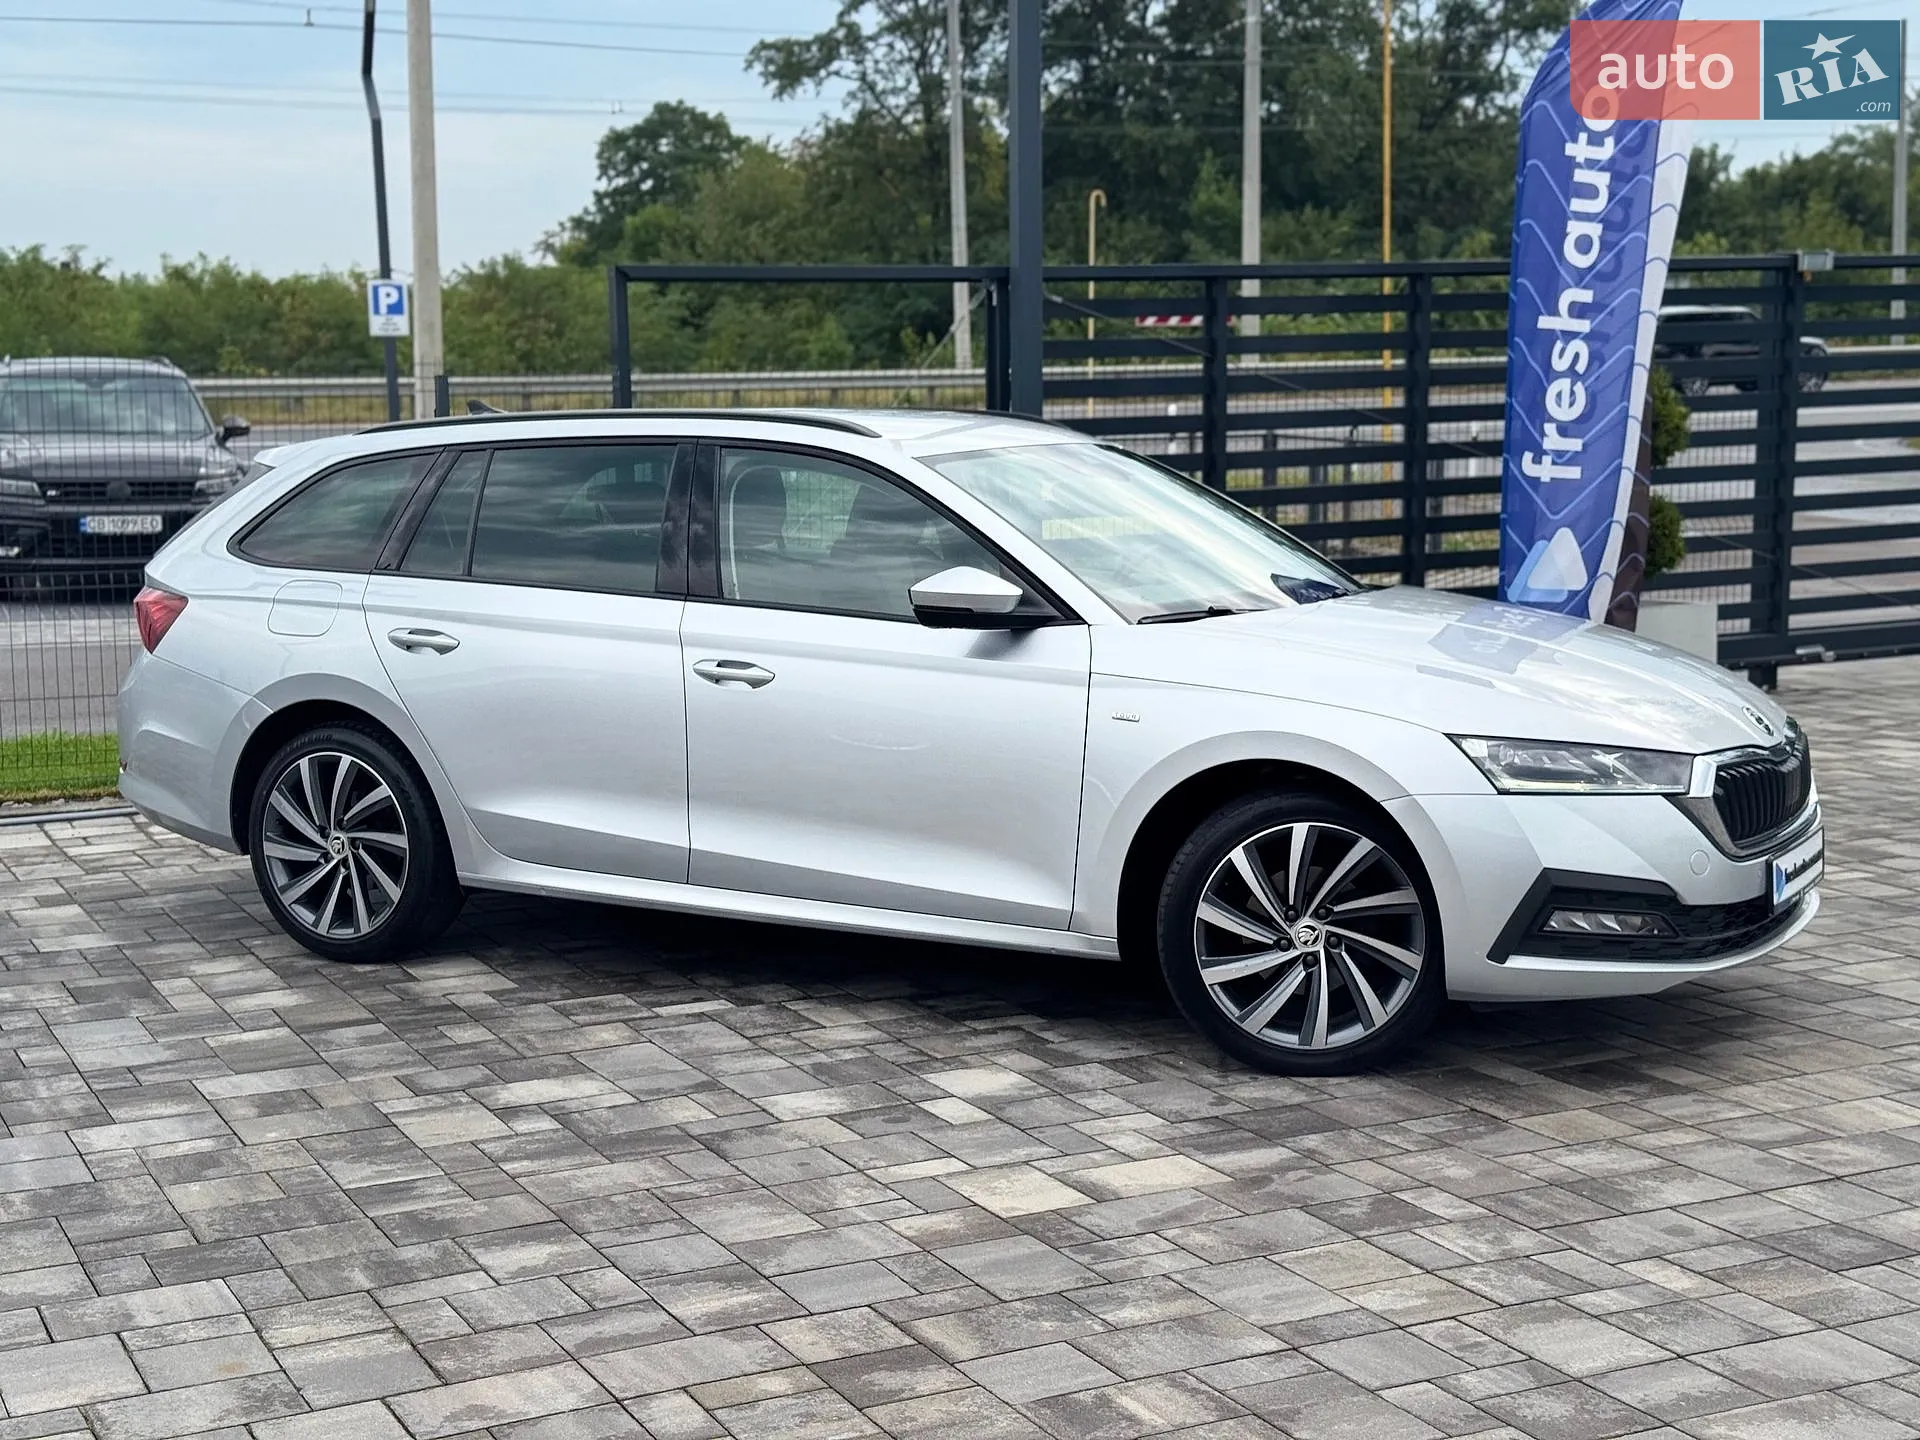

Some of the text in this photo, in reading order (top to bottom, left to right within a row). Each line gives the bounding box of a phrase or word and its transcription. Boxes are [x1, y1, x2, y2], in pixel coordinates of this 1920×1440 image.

[378, 286, 400, 315] P
[1521, 85, 1620, 483] fresh auto
